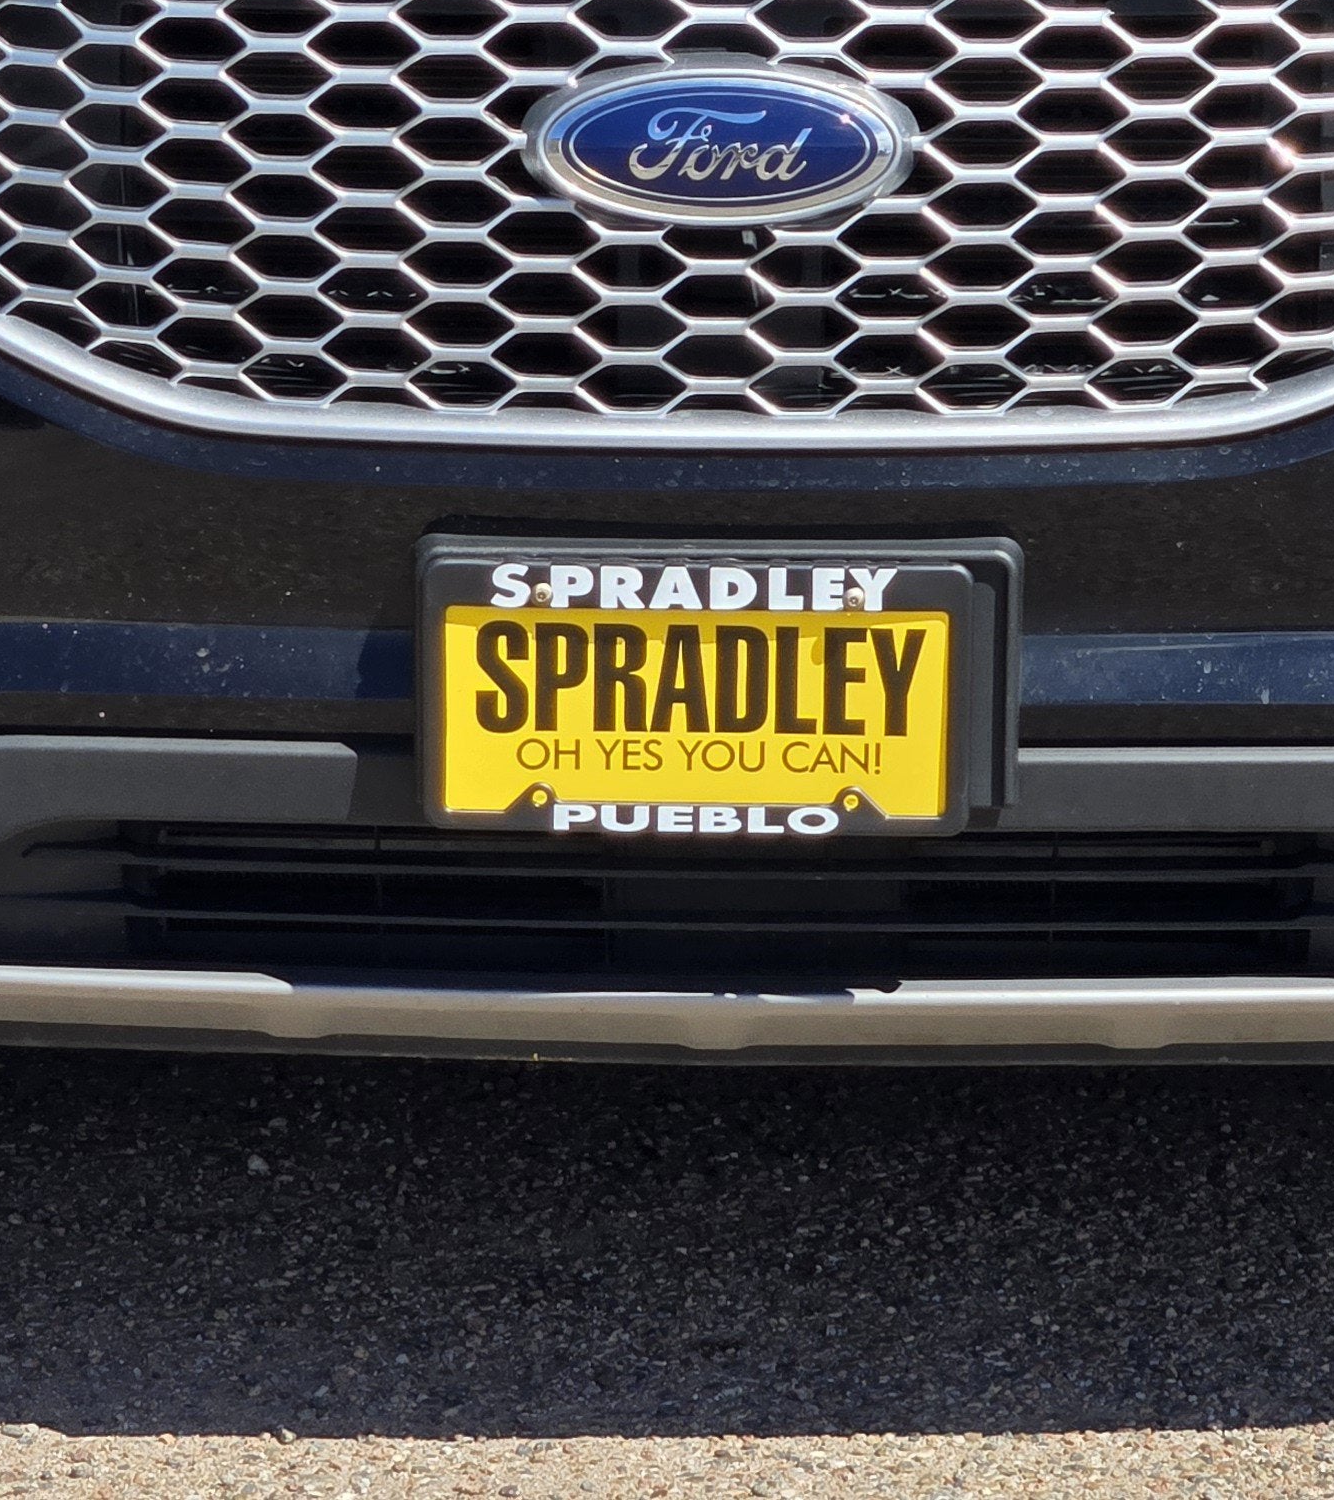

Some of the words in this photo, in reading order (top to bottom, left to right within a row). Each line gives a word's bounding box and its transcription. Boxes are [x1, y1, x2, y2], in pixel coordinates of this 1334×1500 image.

[628, 106, 814, 180] Ford
[489, 563, 898, 612] SPRADLEY
[475, 620, 927, 737] SPRADLEY
[516, 738, 581, 771] OH
[596, 739, 664, 772] YES
[677, 740, 767, 774] YOU
[781, 742, 882, 775] CAN!
[552, 804, 840, 834] PUEBLO
